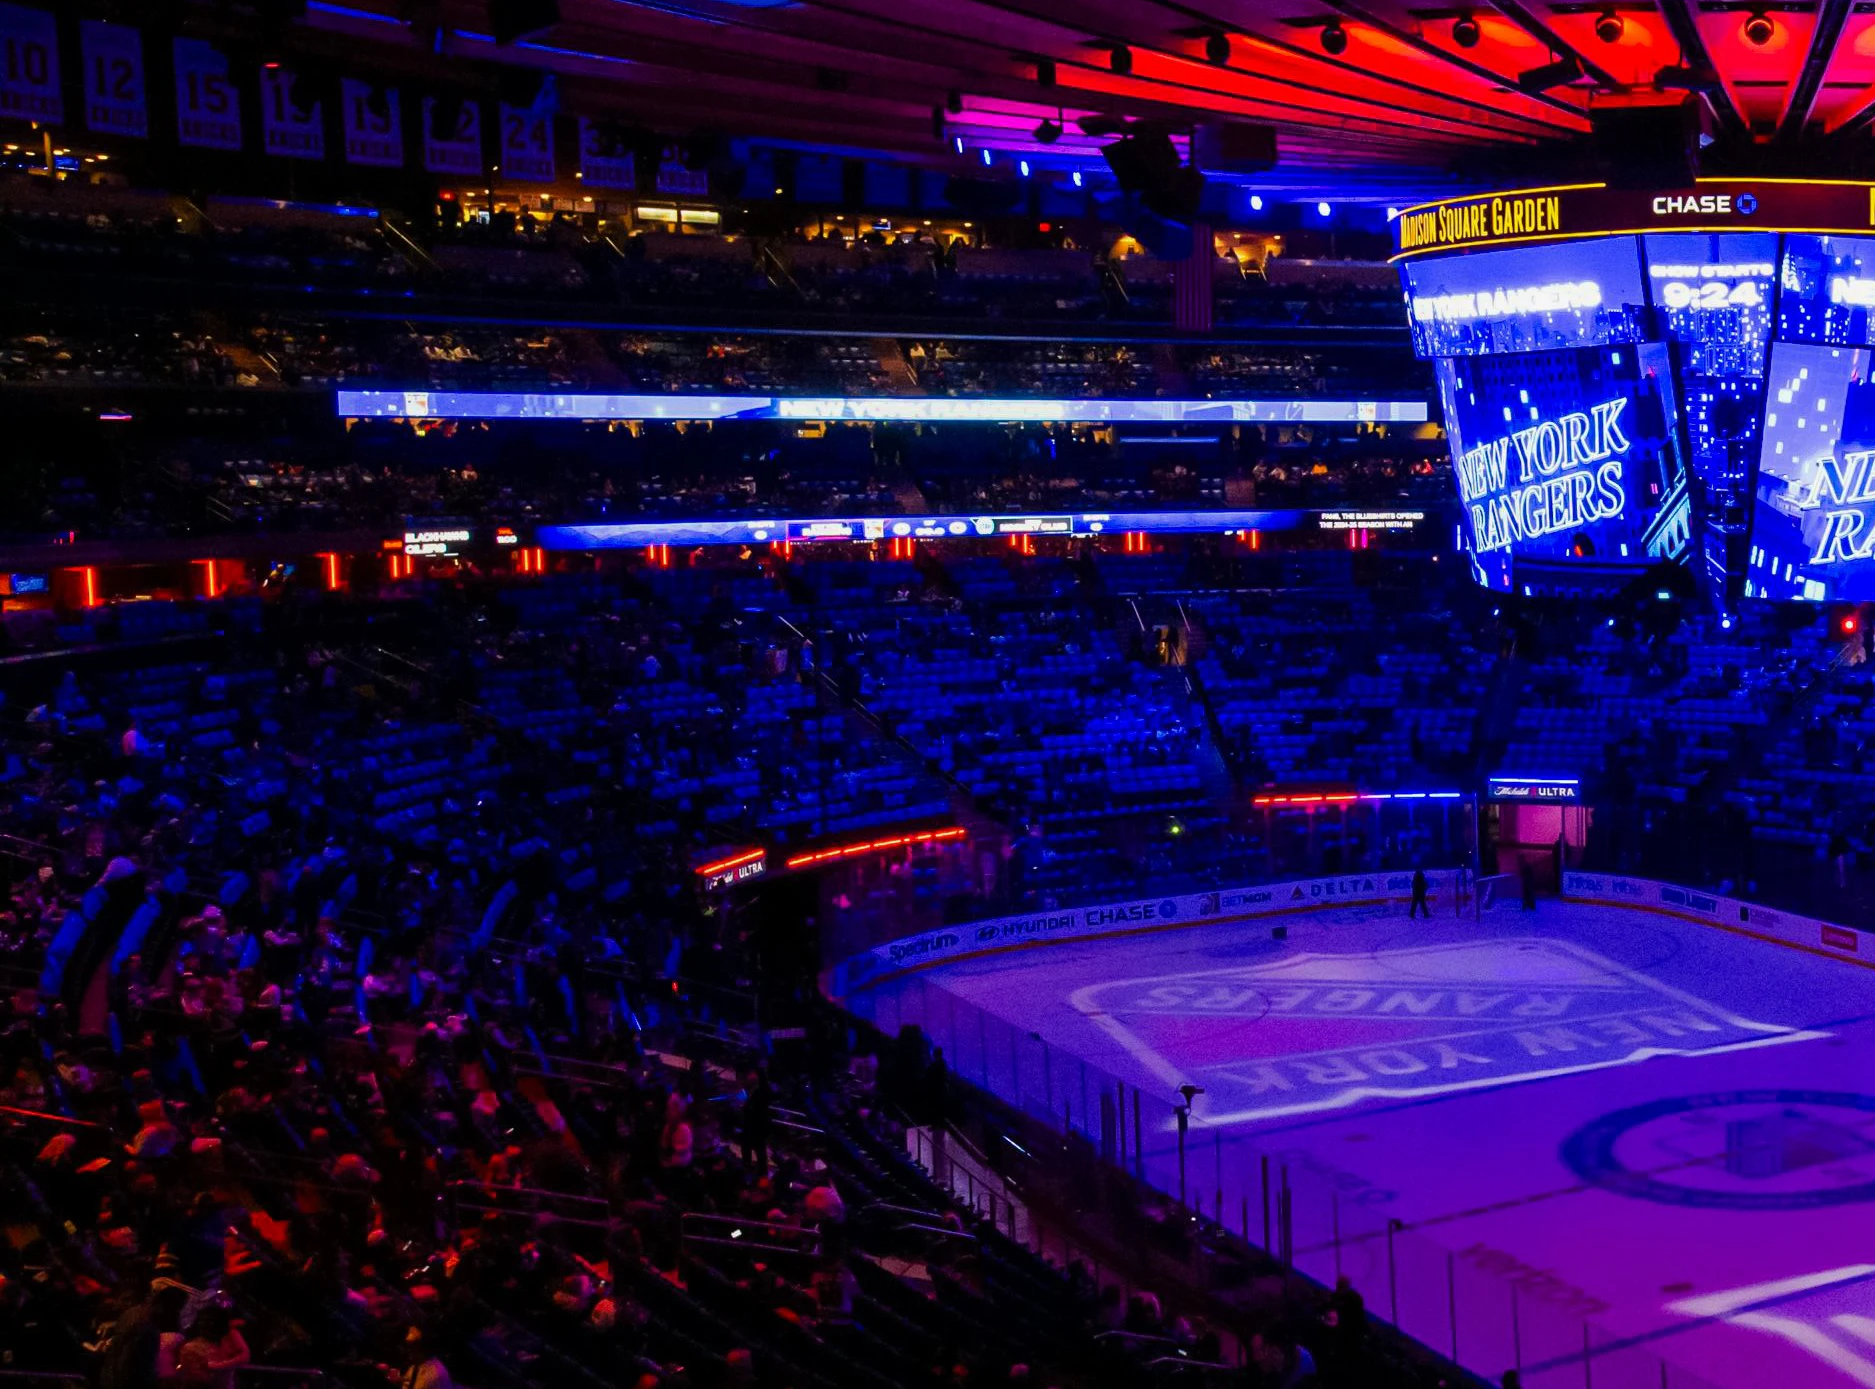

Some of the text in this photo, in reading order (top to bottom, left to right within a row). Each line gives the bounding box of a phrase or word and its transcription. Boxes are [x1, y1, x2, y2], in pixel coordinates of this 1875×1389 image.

[9, 37, 49, 86] 10
[96, 56, 135, 101] 12
[187, 72, 230, 113] 15
[1652, 194, 1731, 216] CHASE
[1401, 197, 1560, 249] MADISON SQUARE GARDEN
[1650, 263, 1774, 278] SHOW STARTS
[1477, 281, 1602, 317] RANGERS
[1663, 281, 1763, 309] 9:24
[1458, 397, 1631, 502] NEW YORK
[1341, 512, 1356, 520] THE
[1396, 512, 1424, 520] OPENED
[1472, 461, 1626, 554] RANGERS
[405, 531, 469, 543] BLACKHAWKS
[1538, 787, 1576, 797] ULTRA
[738, 861, 763, 879] ULTRA
[1310, 878, 1375, 897] DELTA
[1003, 916, 1075, 938] HYUNDAI
[1085, 902, 1156, 927] CHASE
[1141, 984, 1577, 1018] RANGERS
[1214, 1005, 1728, 1096] NEW YORK
